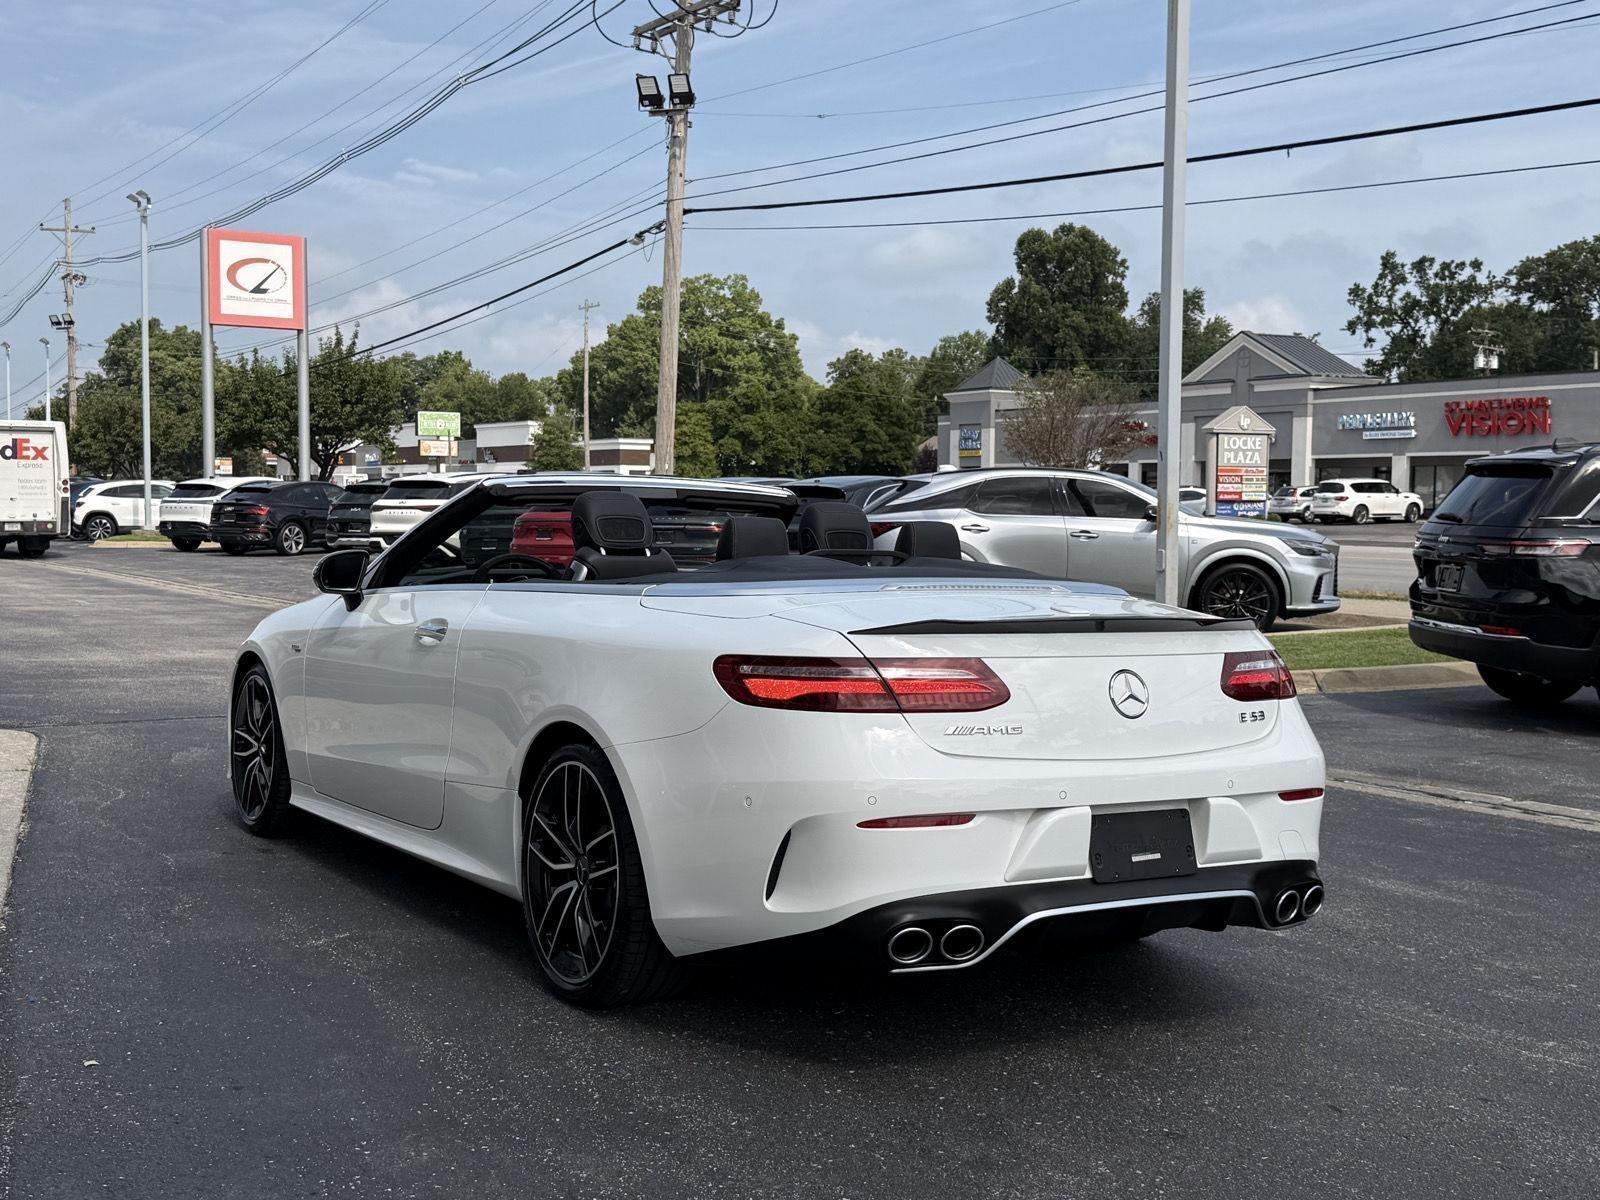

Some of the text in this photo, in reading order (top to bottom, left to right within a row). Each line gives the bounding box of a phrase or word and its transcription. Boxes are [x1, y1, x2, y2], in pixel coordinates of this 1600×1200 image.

[1444, 408, 1551, 438] VISION
[1224, 436, 1262, 450] LOCKE
[1224, 451, 1261, 464] PLAZA
[1218, 475, 1241, 483] VISION
[1239, 711, 1265, 723] E 53
